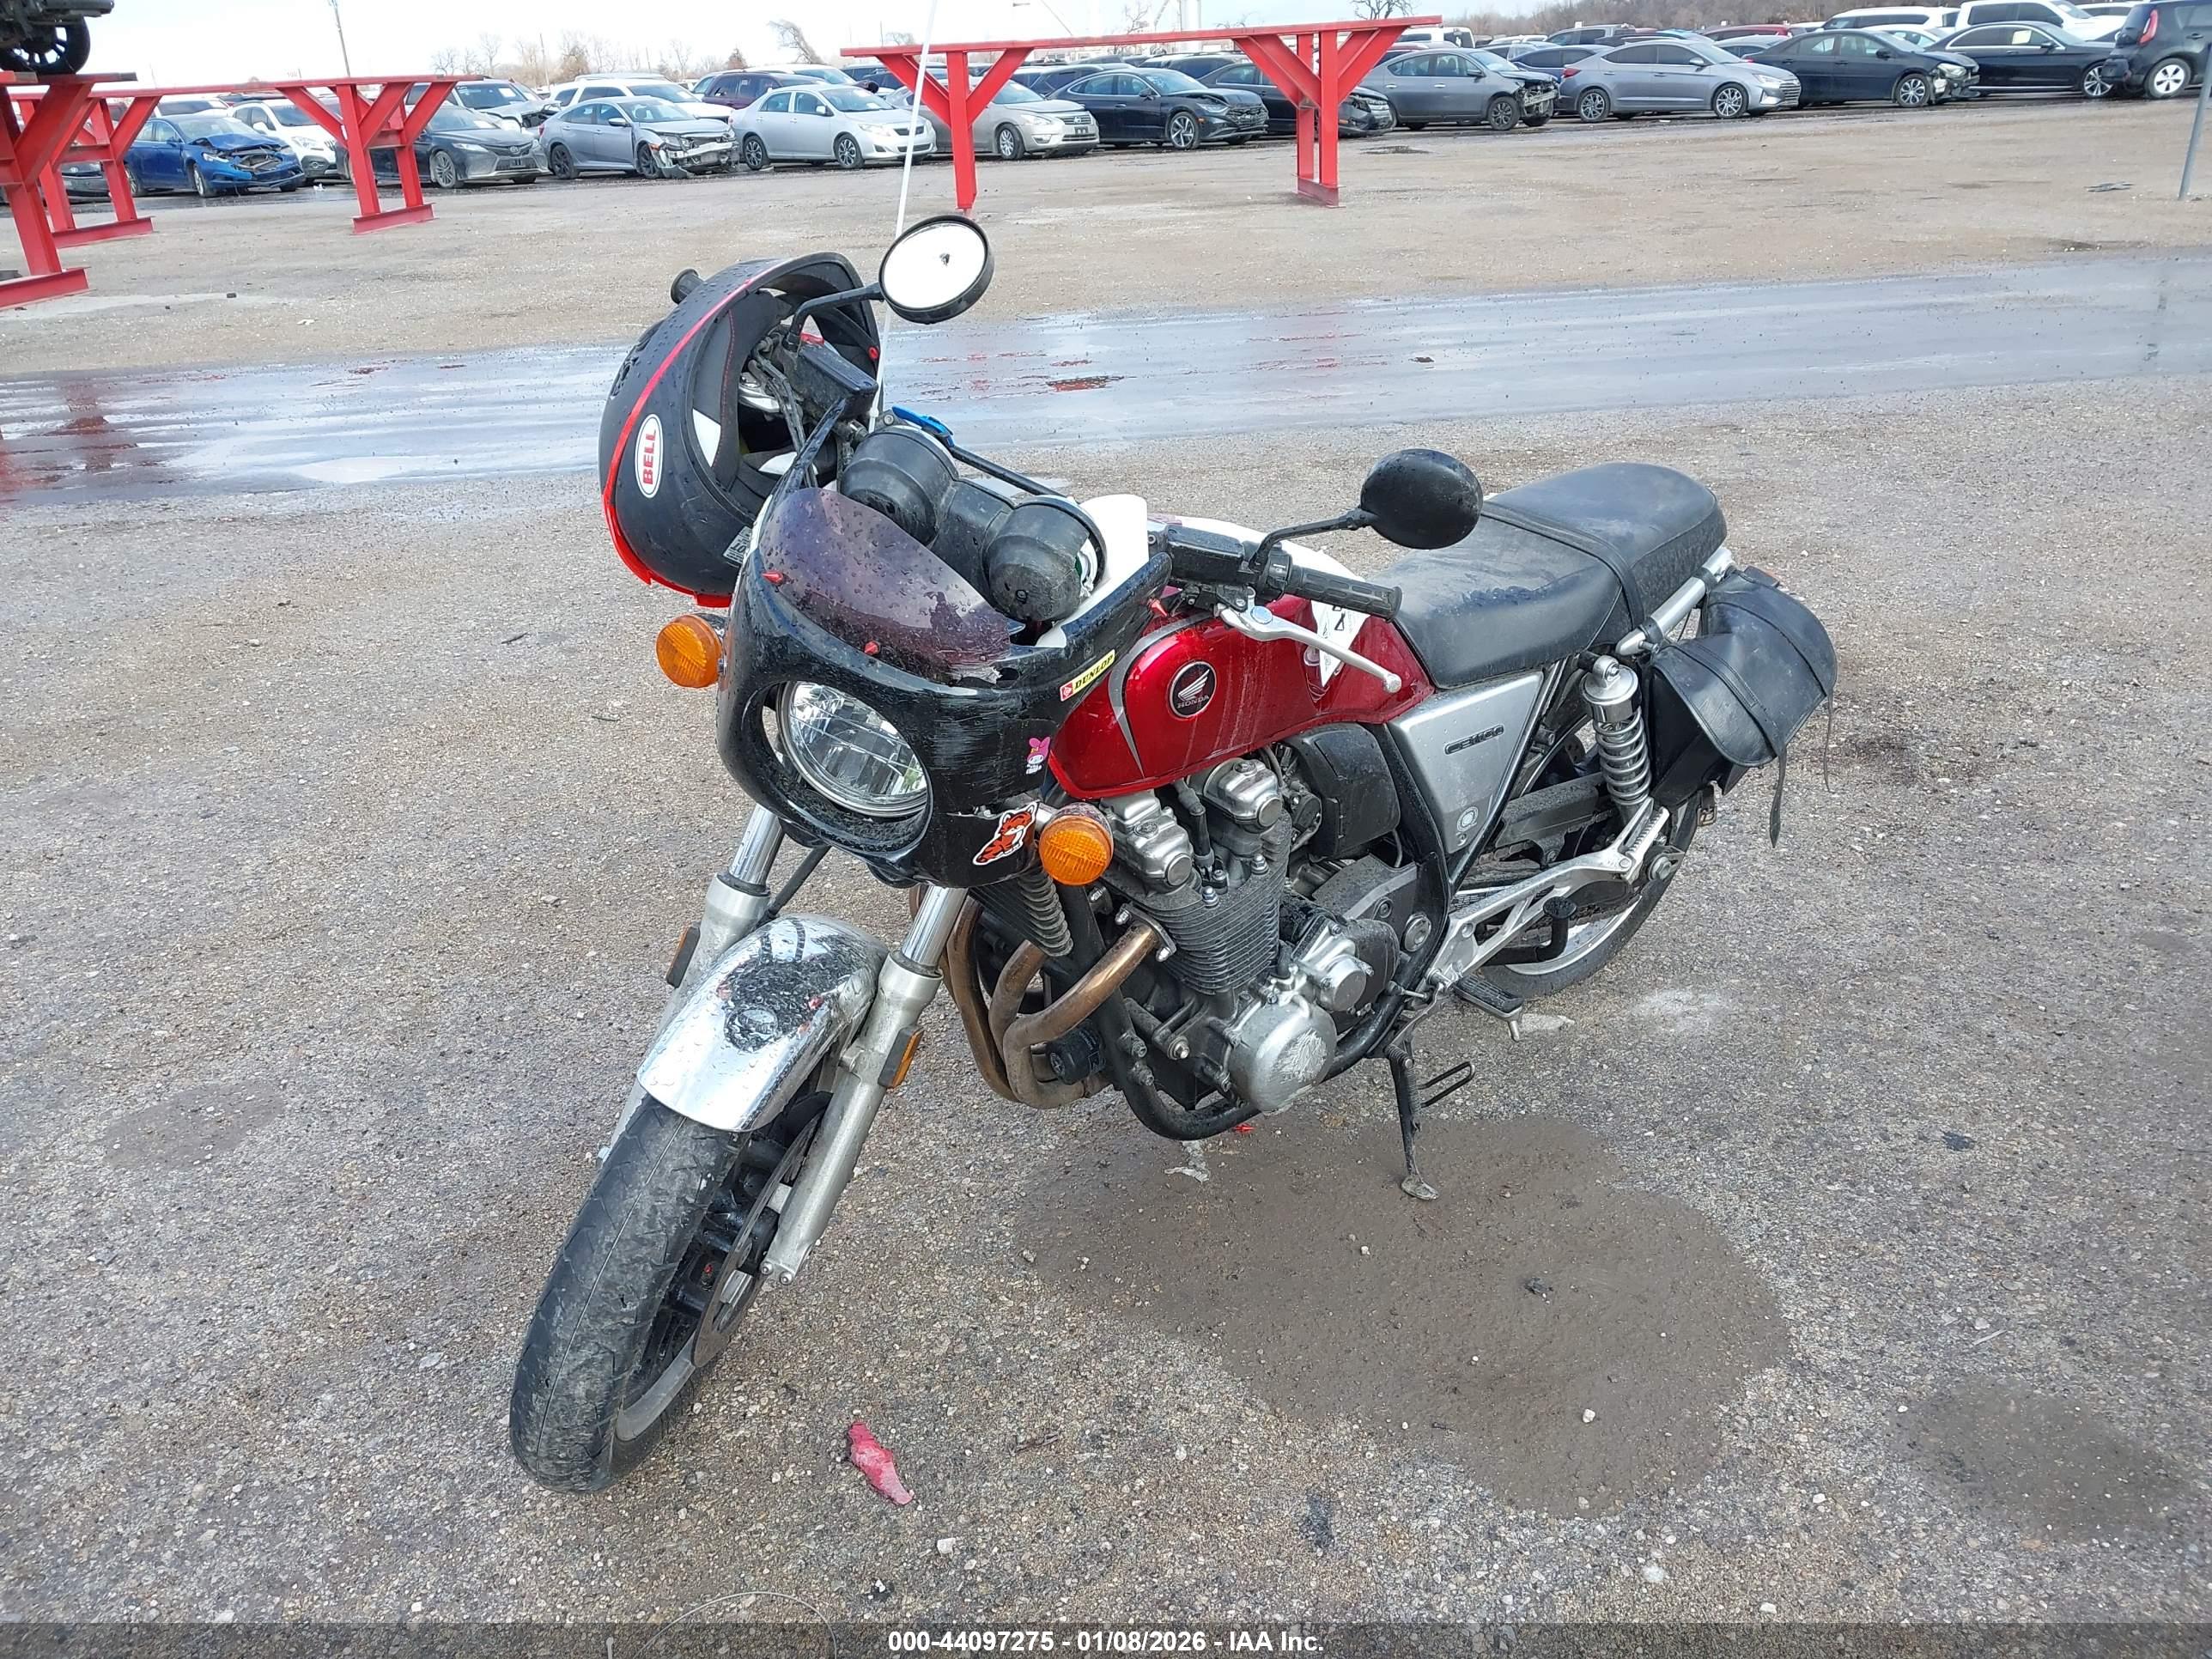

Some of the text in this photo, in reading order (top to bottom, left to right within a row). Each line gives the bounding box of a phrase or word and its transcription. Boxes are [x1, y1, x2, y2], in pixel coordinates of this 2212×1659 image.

[642, 429, 657, 485] BELL
[1074, 654, 1114, 690] DUNLOP
[1177, 695, 1210, 708] HONDA
